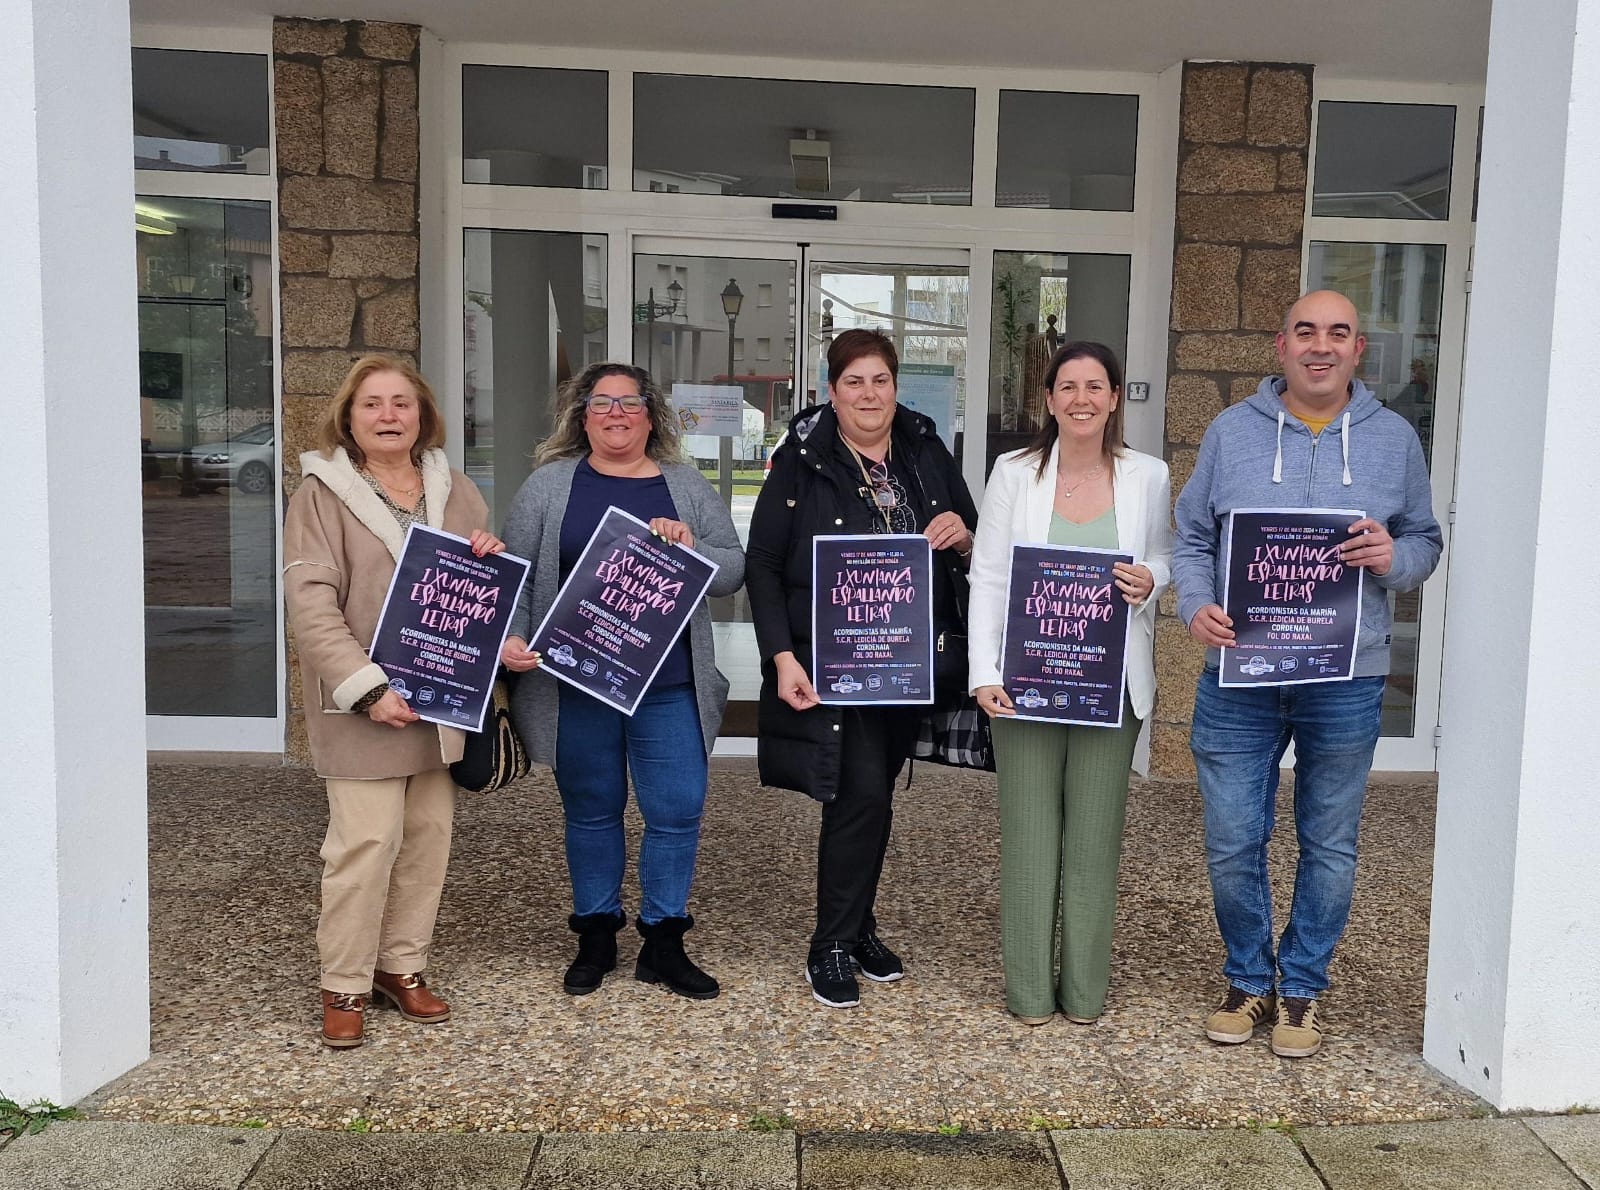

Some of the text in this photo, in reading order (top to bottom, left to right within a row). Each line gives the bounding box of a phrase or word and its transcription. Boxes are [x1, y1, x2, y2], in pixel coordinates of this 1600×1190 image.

[1247, 561, 1343, 583] ESPALLANDO
[596, 561, 676, 615] ESPALLANDO
[831, 586, 915, 605] ESPALLANDO
[411, 583, 496, 624] ESPALLANDO
[1025, 597, 1113, 622] ESPALLANDO
[1247, 606, 1298, 616] ACORDIONISTAS
[1310, 608, 1336, 616] MARIÑA
[577, 607, 644, 648] S.C.R. LEDICIA DE BURELA
[579, 599, 651, 643] ACORDIONISTAS DA MARIÑA
[1269, 615, 1295, 623] LEDICIA
[1307, 615, 1334, 624] BURELA
[400, 627, 480, 656] ACORDIONISTAS DA MARIÑA
[584, 629, 595, 639] FOL
[595, 635, 604, 644] DO
[603, 640, 621, 654] RAXAL
[1024, 640, 1071, 651] ACORDIONISTAS
[1082, 646, 1105, 654] MARIÑA
[1292, 632, 1312, 640] RAXAL
[400, 636, 475, 663] S.C.R. LEDICIA DE BURELA
[1025, 648, 1042, 657] S.C.R.
[1044, 650, 1067, 659] LEDICIA
[1078, 653, 1102, 662] BURELA
[413, 657, 454, 675] FOL DO RAXAL
[1064, 668, 1083, 676] RAXAL
